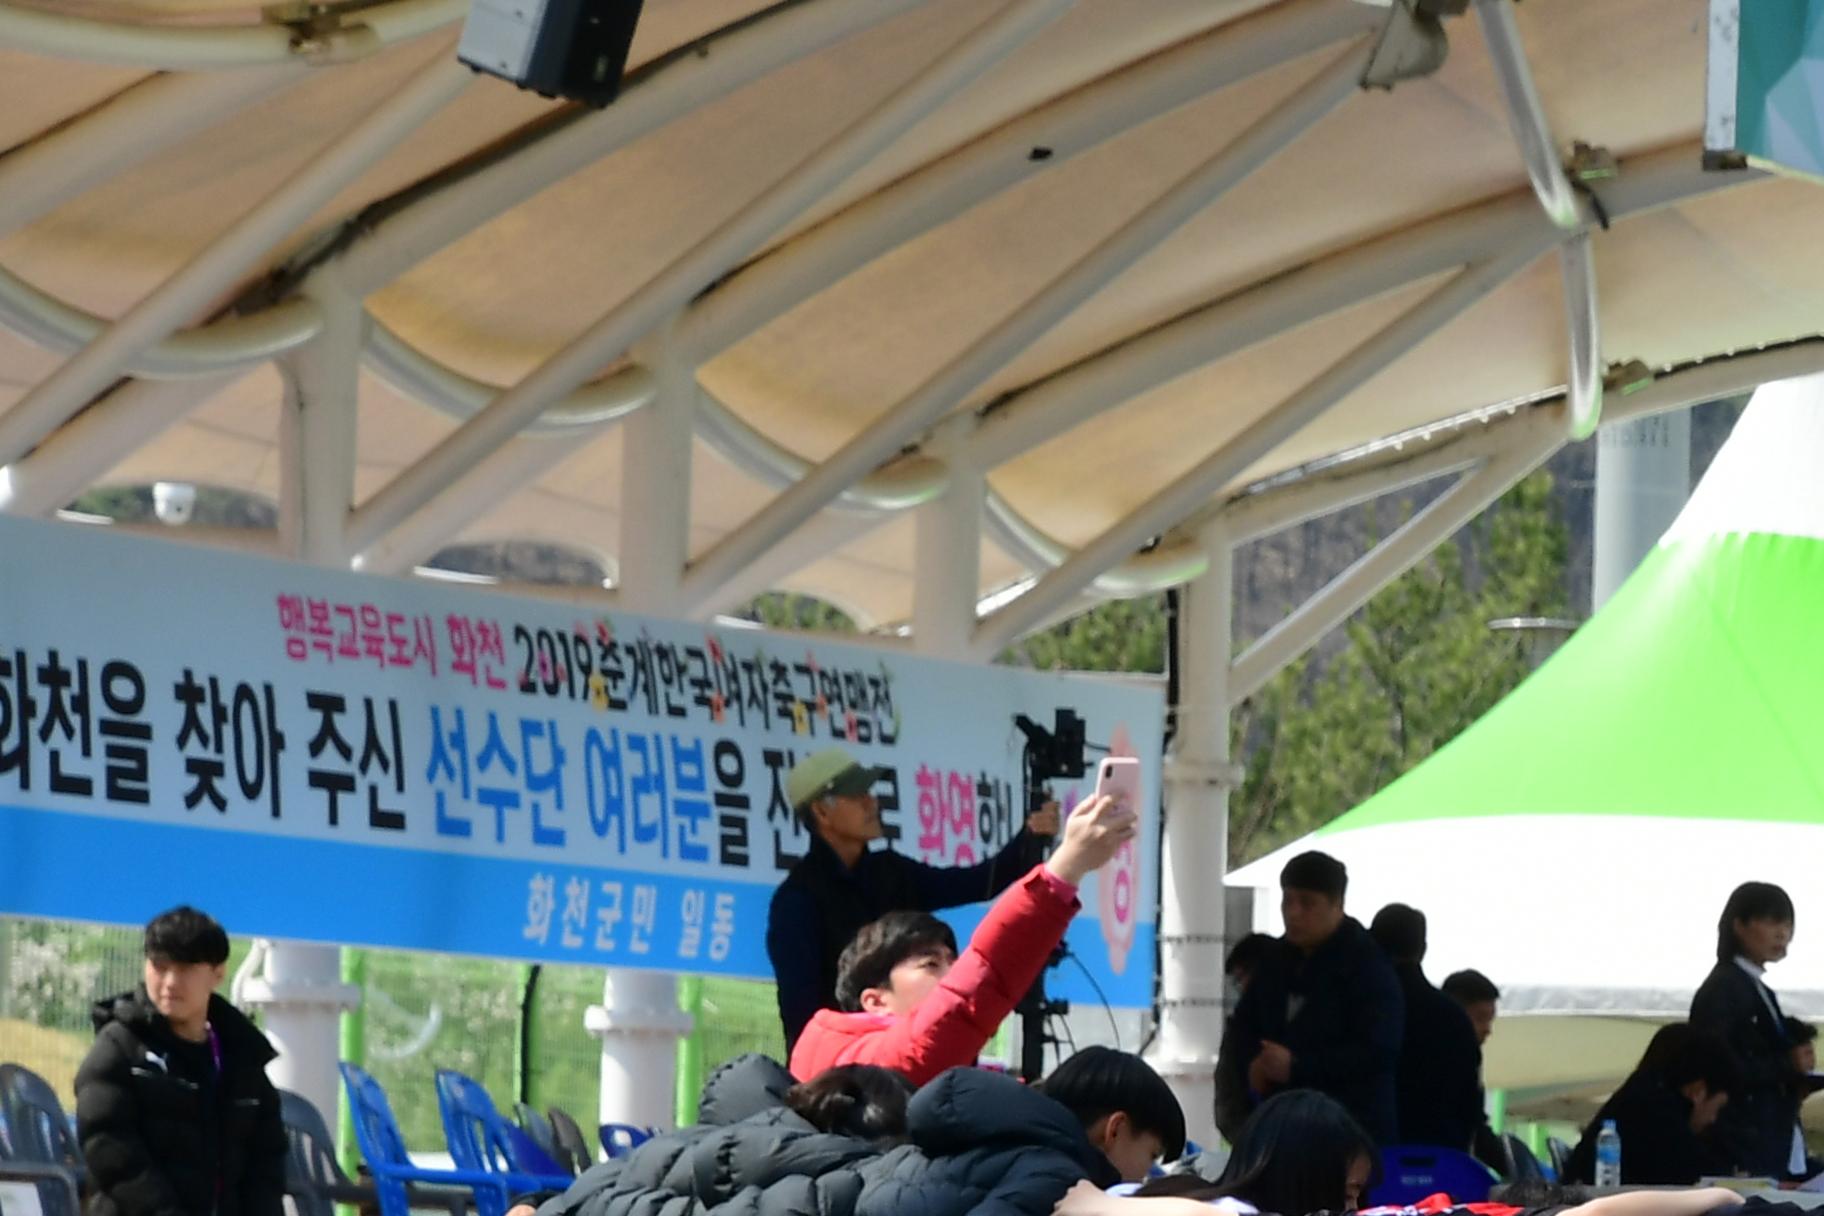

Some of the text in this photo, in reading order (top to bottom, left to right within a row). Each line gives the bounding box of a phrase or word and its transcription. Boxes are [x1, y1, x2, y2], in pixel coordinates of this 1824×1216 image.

[277, 591, 438, 677] 행복교육도시
[446, 611, 508, 690] 화천
[173, 667, 286, 819] 찾아
[305, 690, 407, 831] 주신
[425, 705, 567, 847] 선수단
[584, 724, 751, 868] 여러분을
[522, 872, 735, 962] 화천군민 일동
